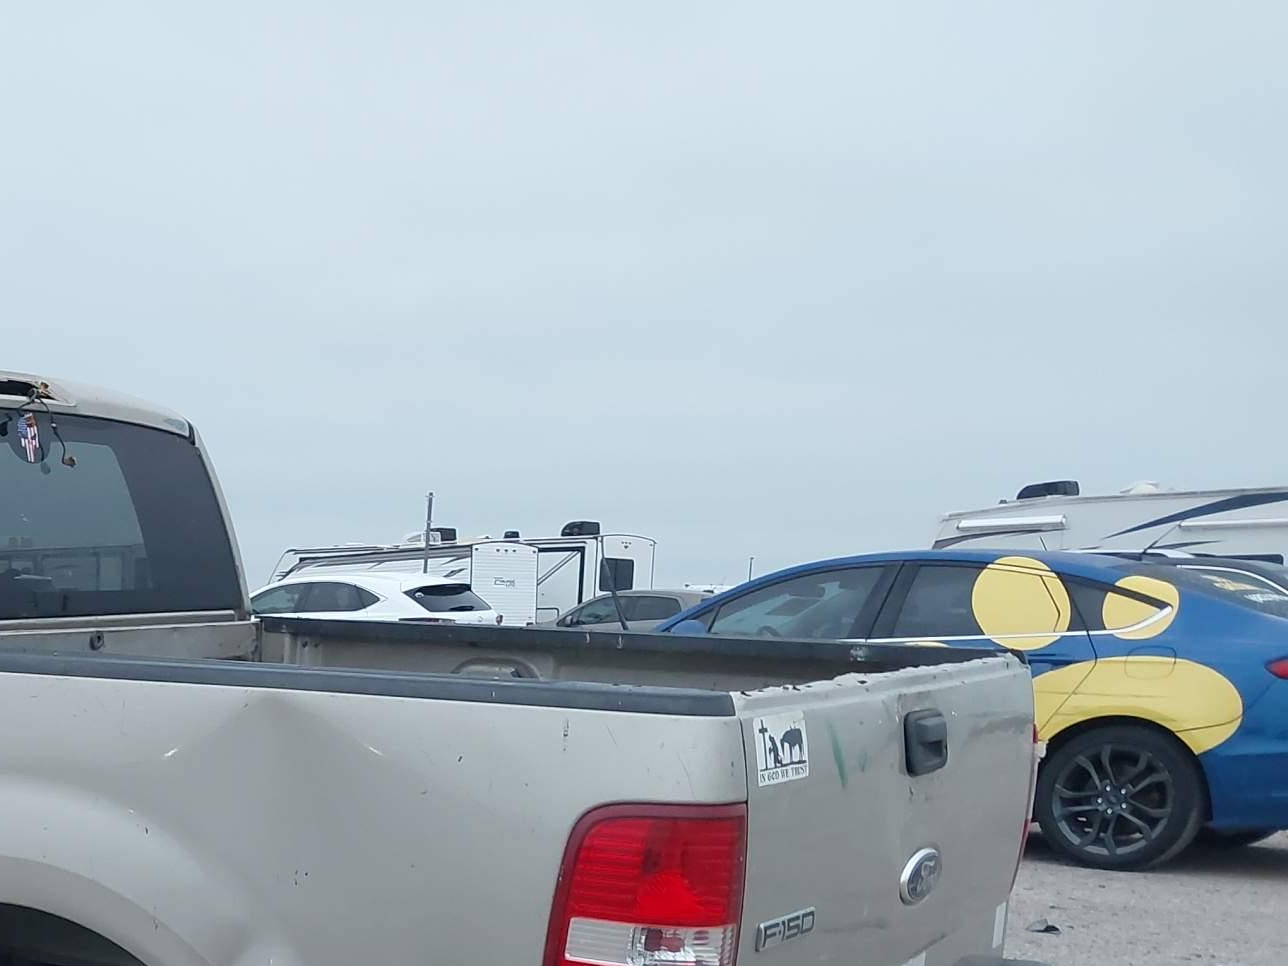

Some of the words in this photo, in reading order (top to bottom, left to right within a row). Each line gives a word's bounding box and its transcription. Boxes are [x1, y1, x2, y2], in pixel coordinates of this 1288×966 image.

[767, 770, 779, 782] GOD
[781, 768, 789, 779] WE
[791, 764, 807, 777] TRUST
